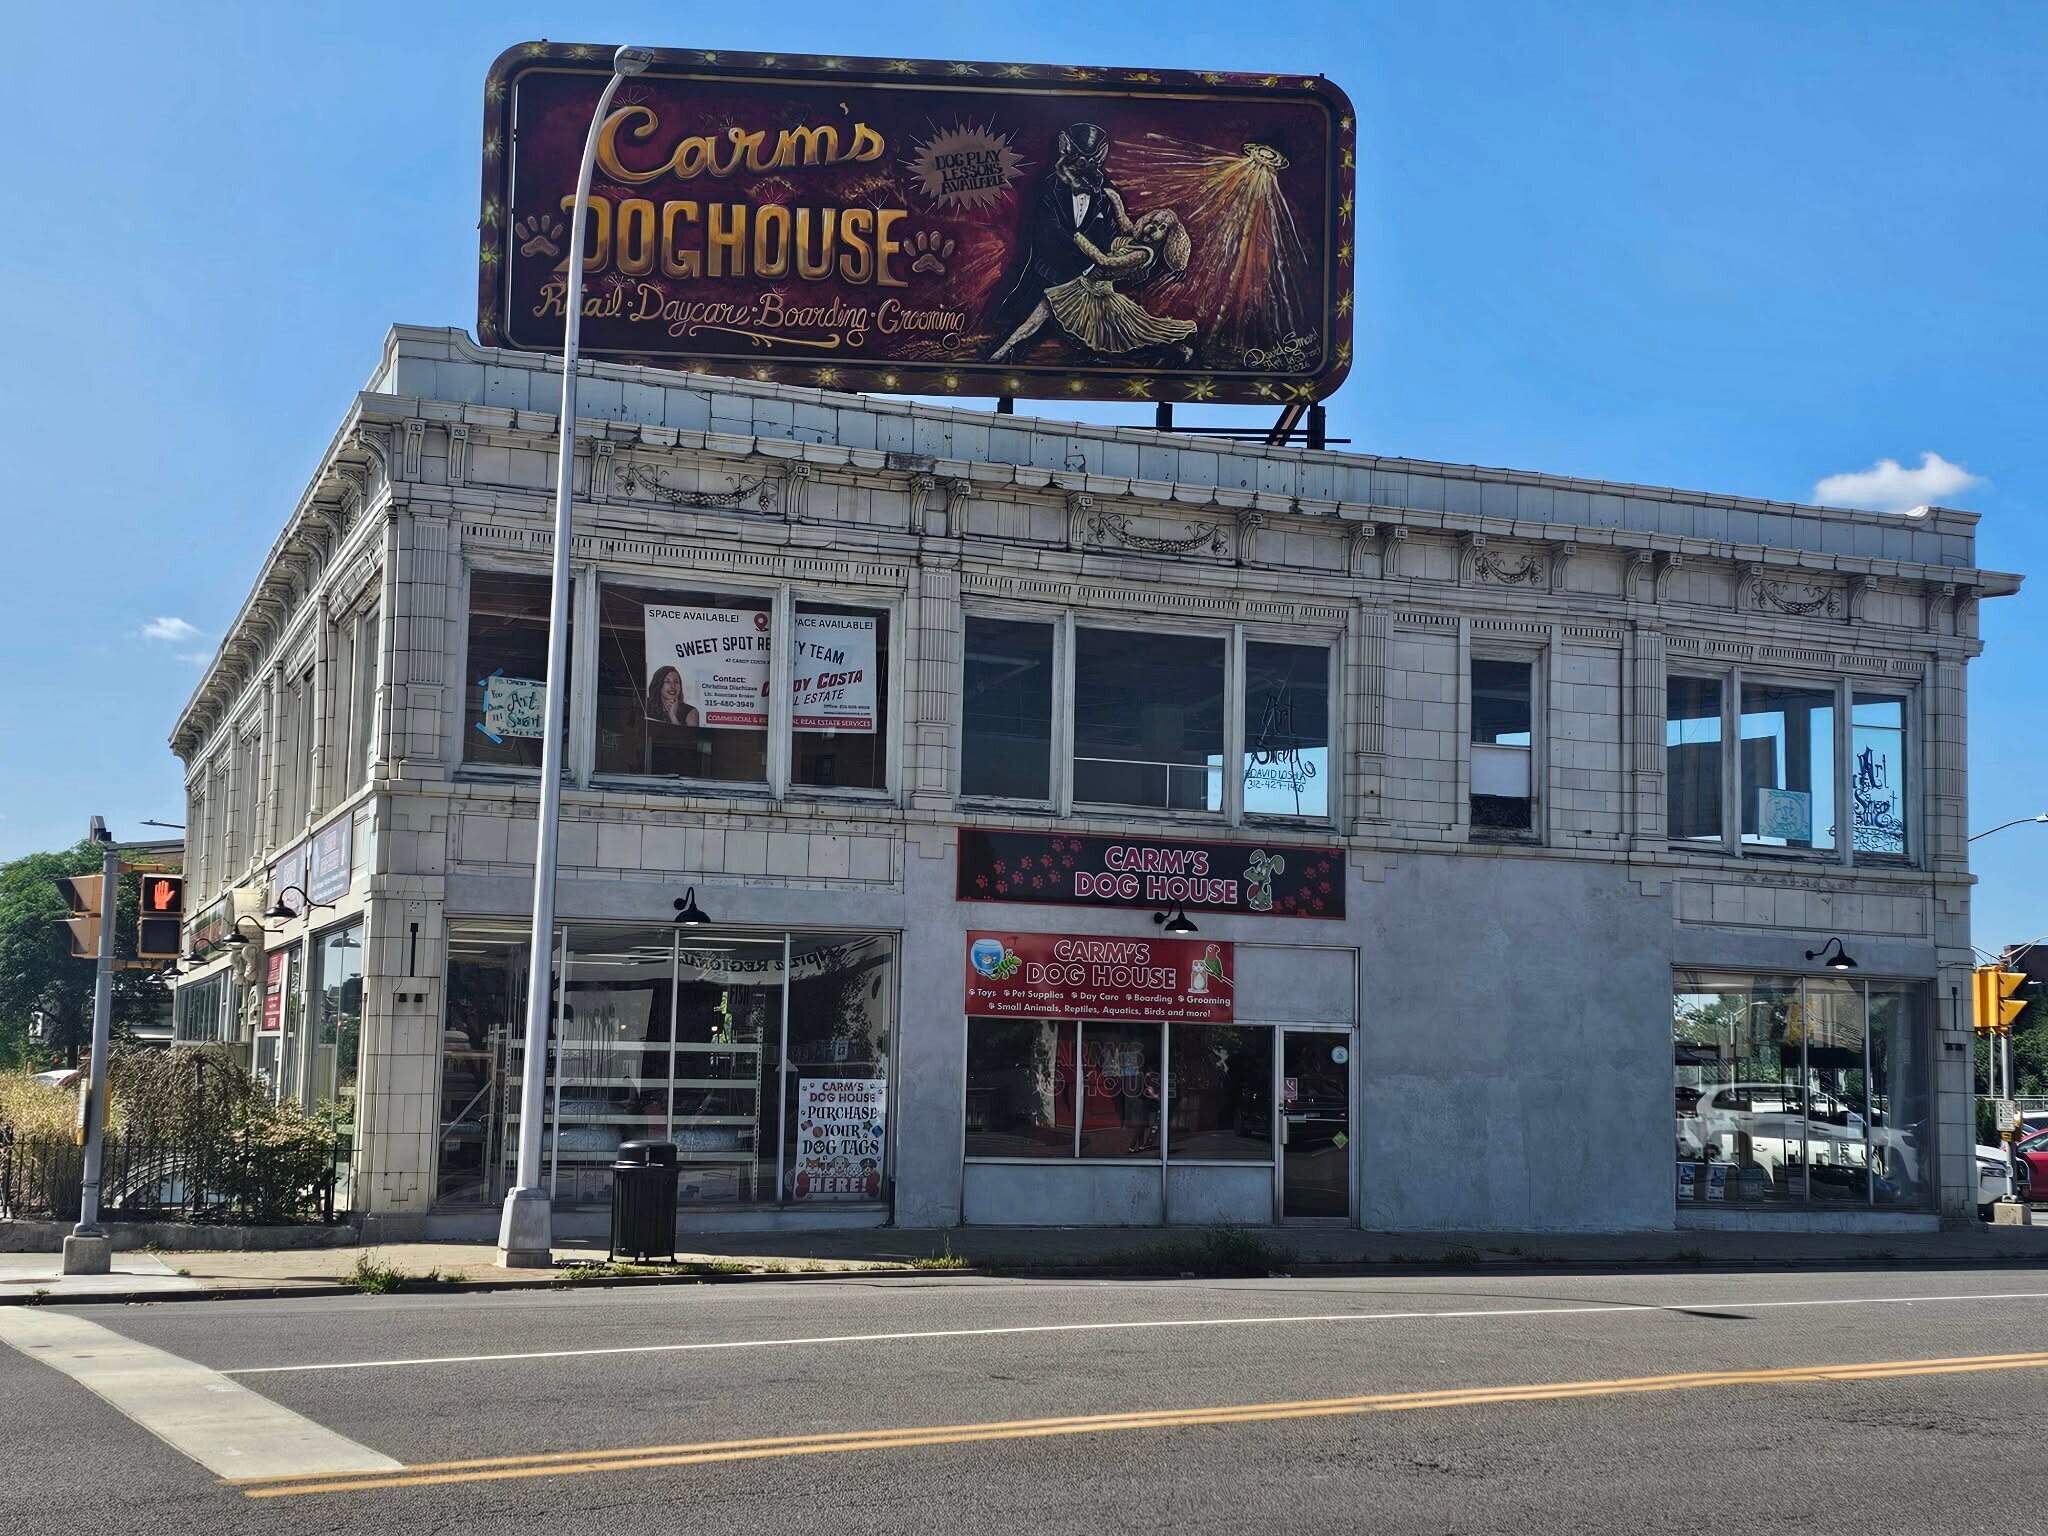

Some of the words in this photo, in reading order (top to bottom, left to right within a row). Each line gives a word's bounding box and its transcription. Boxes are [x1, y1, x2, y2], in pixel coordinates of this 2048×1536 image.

[595, 101, 884, 184] Carm's
[935, 152, 963, 170] DOG
[966, 150, 1001, 165] PLAY
[942, 162, 1003, 181] LESSONS
[555, 195, 908, 287] DOGHOUSE
[533, 282, 622, 318] Rtail
[630, 283, 750, 336] Daycare
[754, 293, 870, 347] Boarding
[877, 298, 965, 350] Grooming
[649, 609, 680, 619] SPACE
[683, 611, 739, 622] AVAILABLE!
[795, 618, 816, 627] ACE
[819, 619, 872, 629] AVAILABLE!
[675, 638, 718, 658] SWEET
[722, 636, 753, 651] SPOT
[810, 643, 845, 665] TEAM
[713, 674, 747, 683] Contact:
[761, 678, 811, 698] CDY
[804, 689, 845, 704] ESTATE
[1250, 769, 1276, 779] DAVID
[1105, 846, 1209, 875] CARM'S
[1075, 872, 1139, 899] DOG
[1147, 875, 1238, 904] HOUSE
[1054, 940, 1150, 964] CARM'S
[1026, 962, 1086, 986] DOG
[1092, 965, 1176, 989] HOUSE
[977, 988, 996, 998] Toys
[1012, 990, 1026, 998] Pet
[1028, 990, 1064, 999] Supplies
[1080, 992, 1097, 1001] Day
[1134, 994, 1173, 1004] Boarding
[1186, 995, 1231, 1006] Grooming
[1024, 1003, 1061, 1013] Animals,
[1064, 1004, 1100, 1014] Reptiles,
[1102, 1006, 1141, 1015] Aquatics,
[1144, 1007, 1165, 1016] Birds
[1167, 1008, 1184, 1016] and
[1186, 1009, 1211, 1017] more!
[822, 1082, 863, 1092] CARM'S
[810, 1093, 835, 1102] DOG
[839, 1093, 875, 1103] HOUSE
[808, 1106, 877, 1121] PURCHASE
[823, 1124, 861, 1139] YOUR
[803, 1140, 836, 1155] DOG
[841, 1140, 879, 1155] TAGS
[809, 1177, 867, 1193] HERE!
